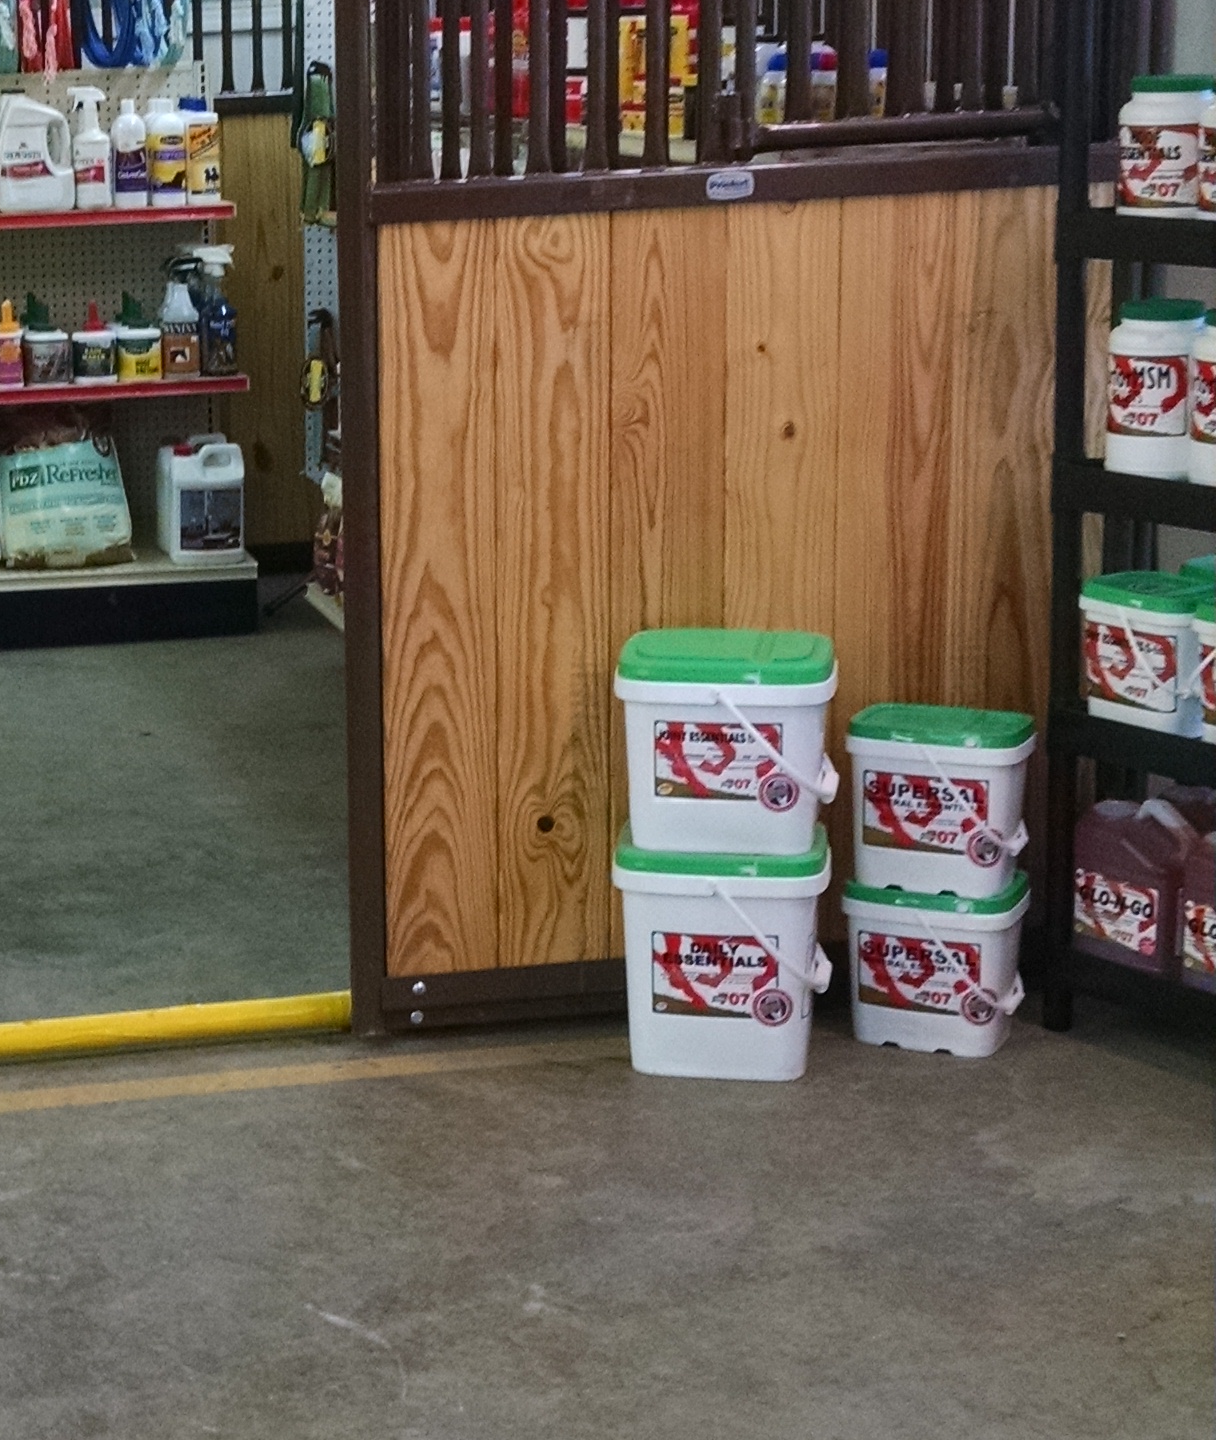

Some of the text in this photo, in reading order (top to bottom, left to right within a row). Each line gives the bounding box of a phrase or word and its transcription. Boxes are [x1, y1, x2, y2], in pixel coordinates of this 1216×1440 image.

[10, 471, 40, 489] PDZ
[690, 942, 741, 956] DAILY
[663, 951, 769, 968] ESSENTIALS
